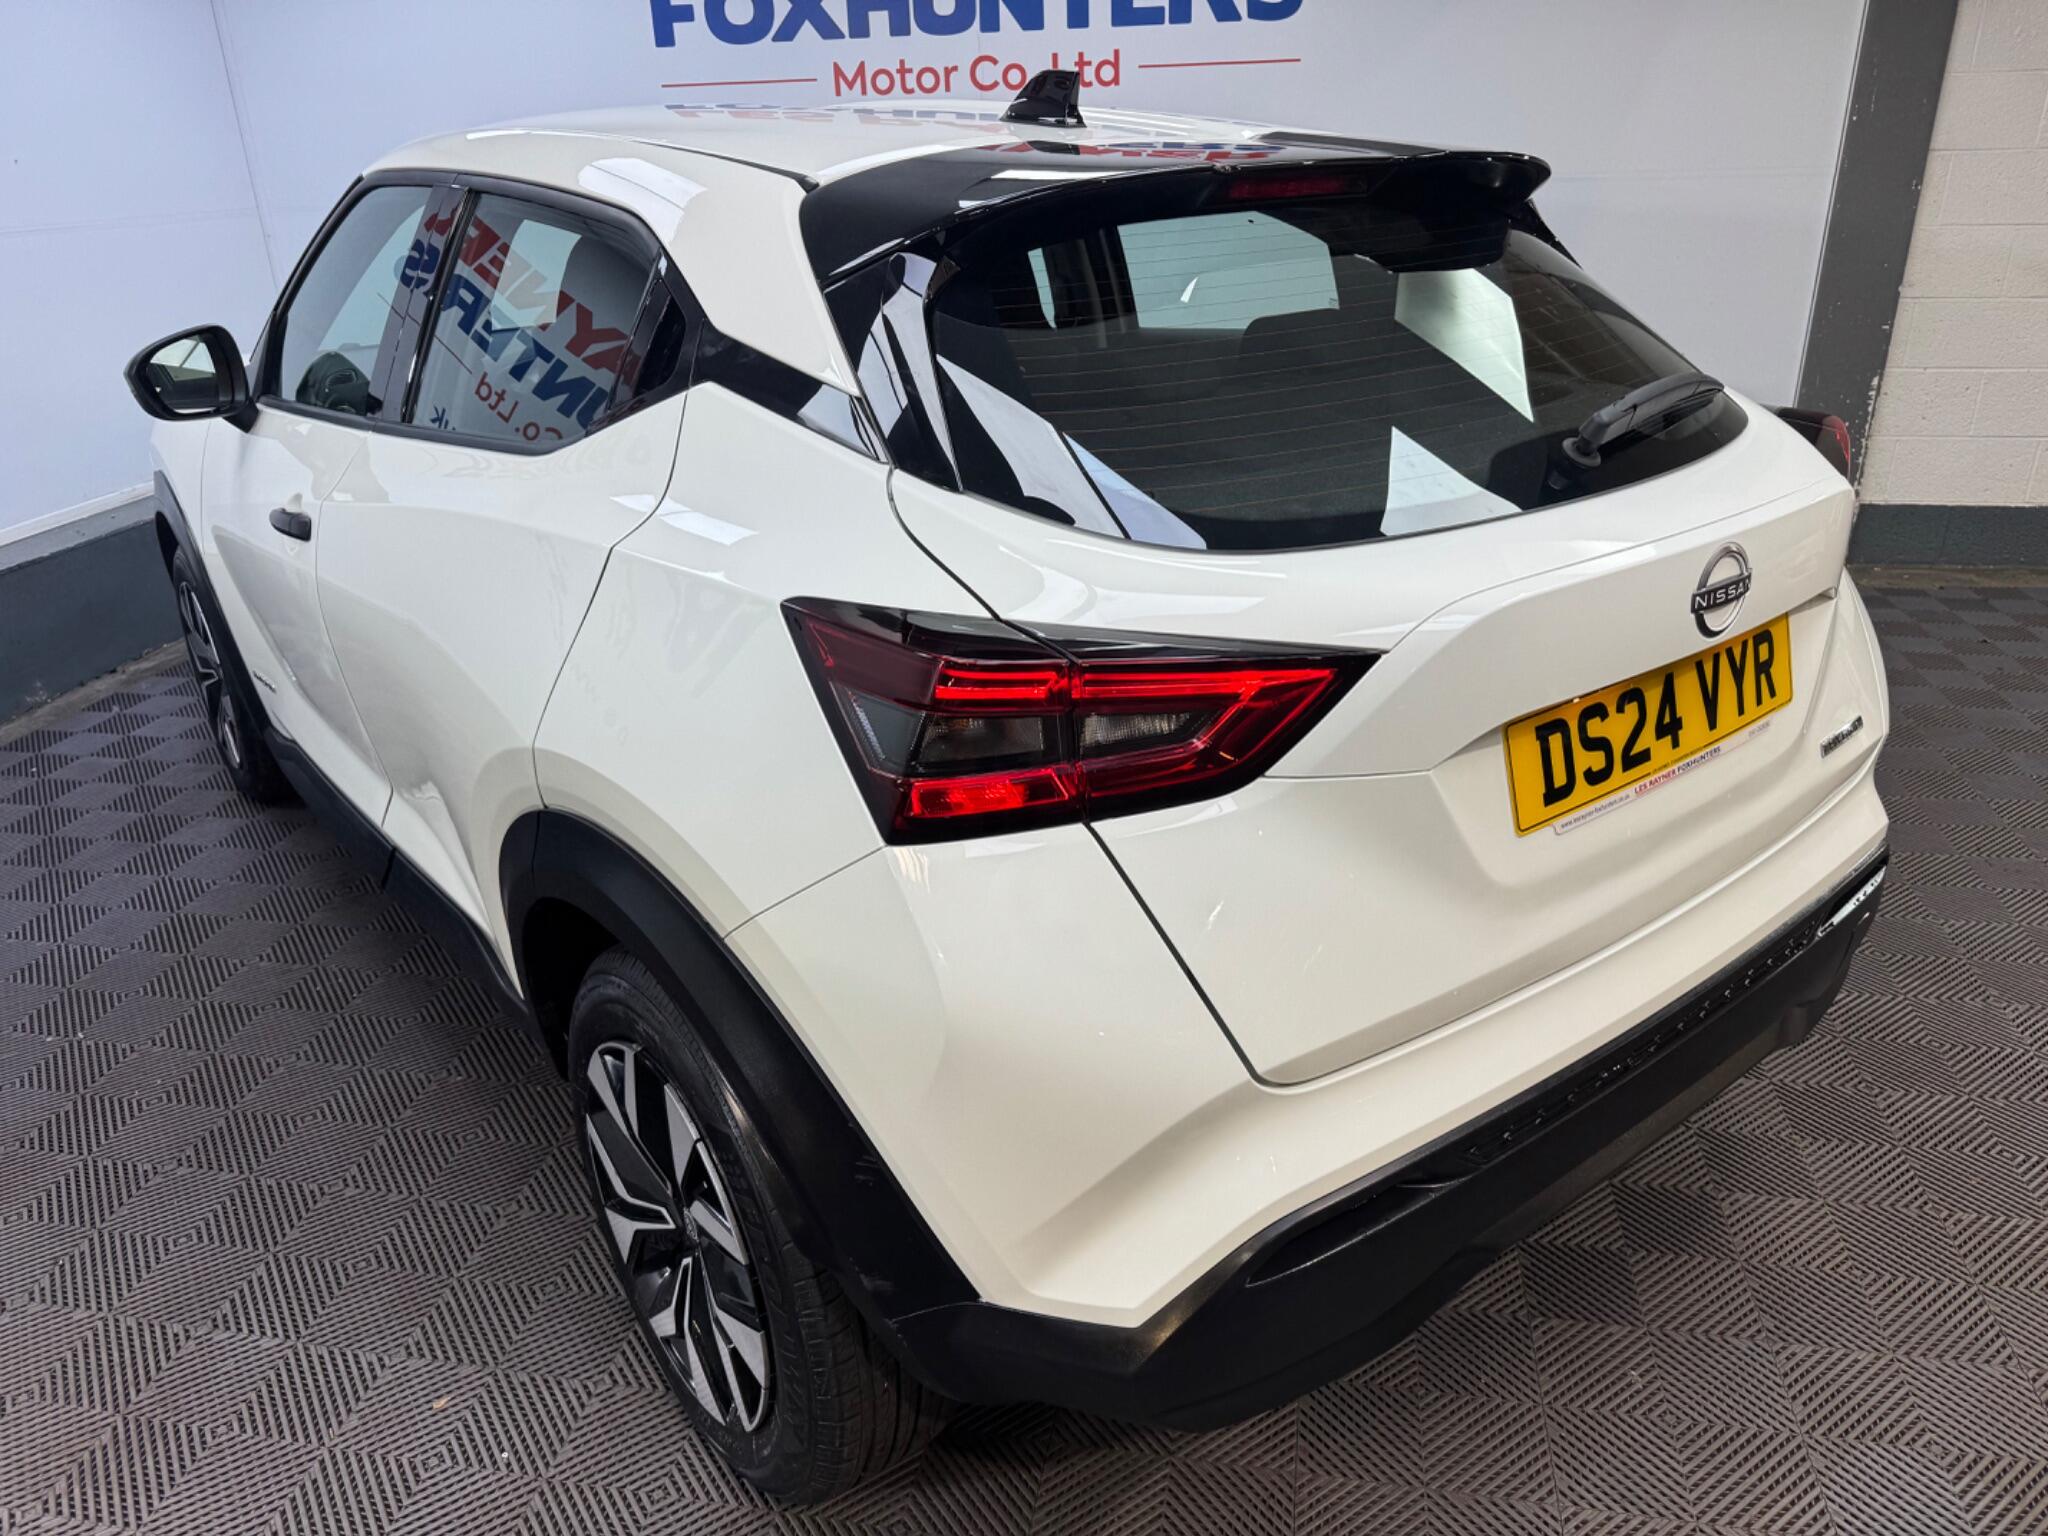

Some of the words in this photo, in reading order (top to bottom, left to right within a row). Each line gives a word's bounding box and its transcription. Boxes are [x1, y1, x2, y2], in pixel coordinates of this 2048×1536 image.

[833, 58, 958, 97] Motor
[1694, 575, 1752, 609] NISSAN
[1535, 672, 1683, 807] DS24
[1695, 629, 1776, 732] VYR
[1649, 770, 1677, 786] RAYNER
[1677, 747, 1721, 773] FOXHUNTERS
